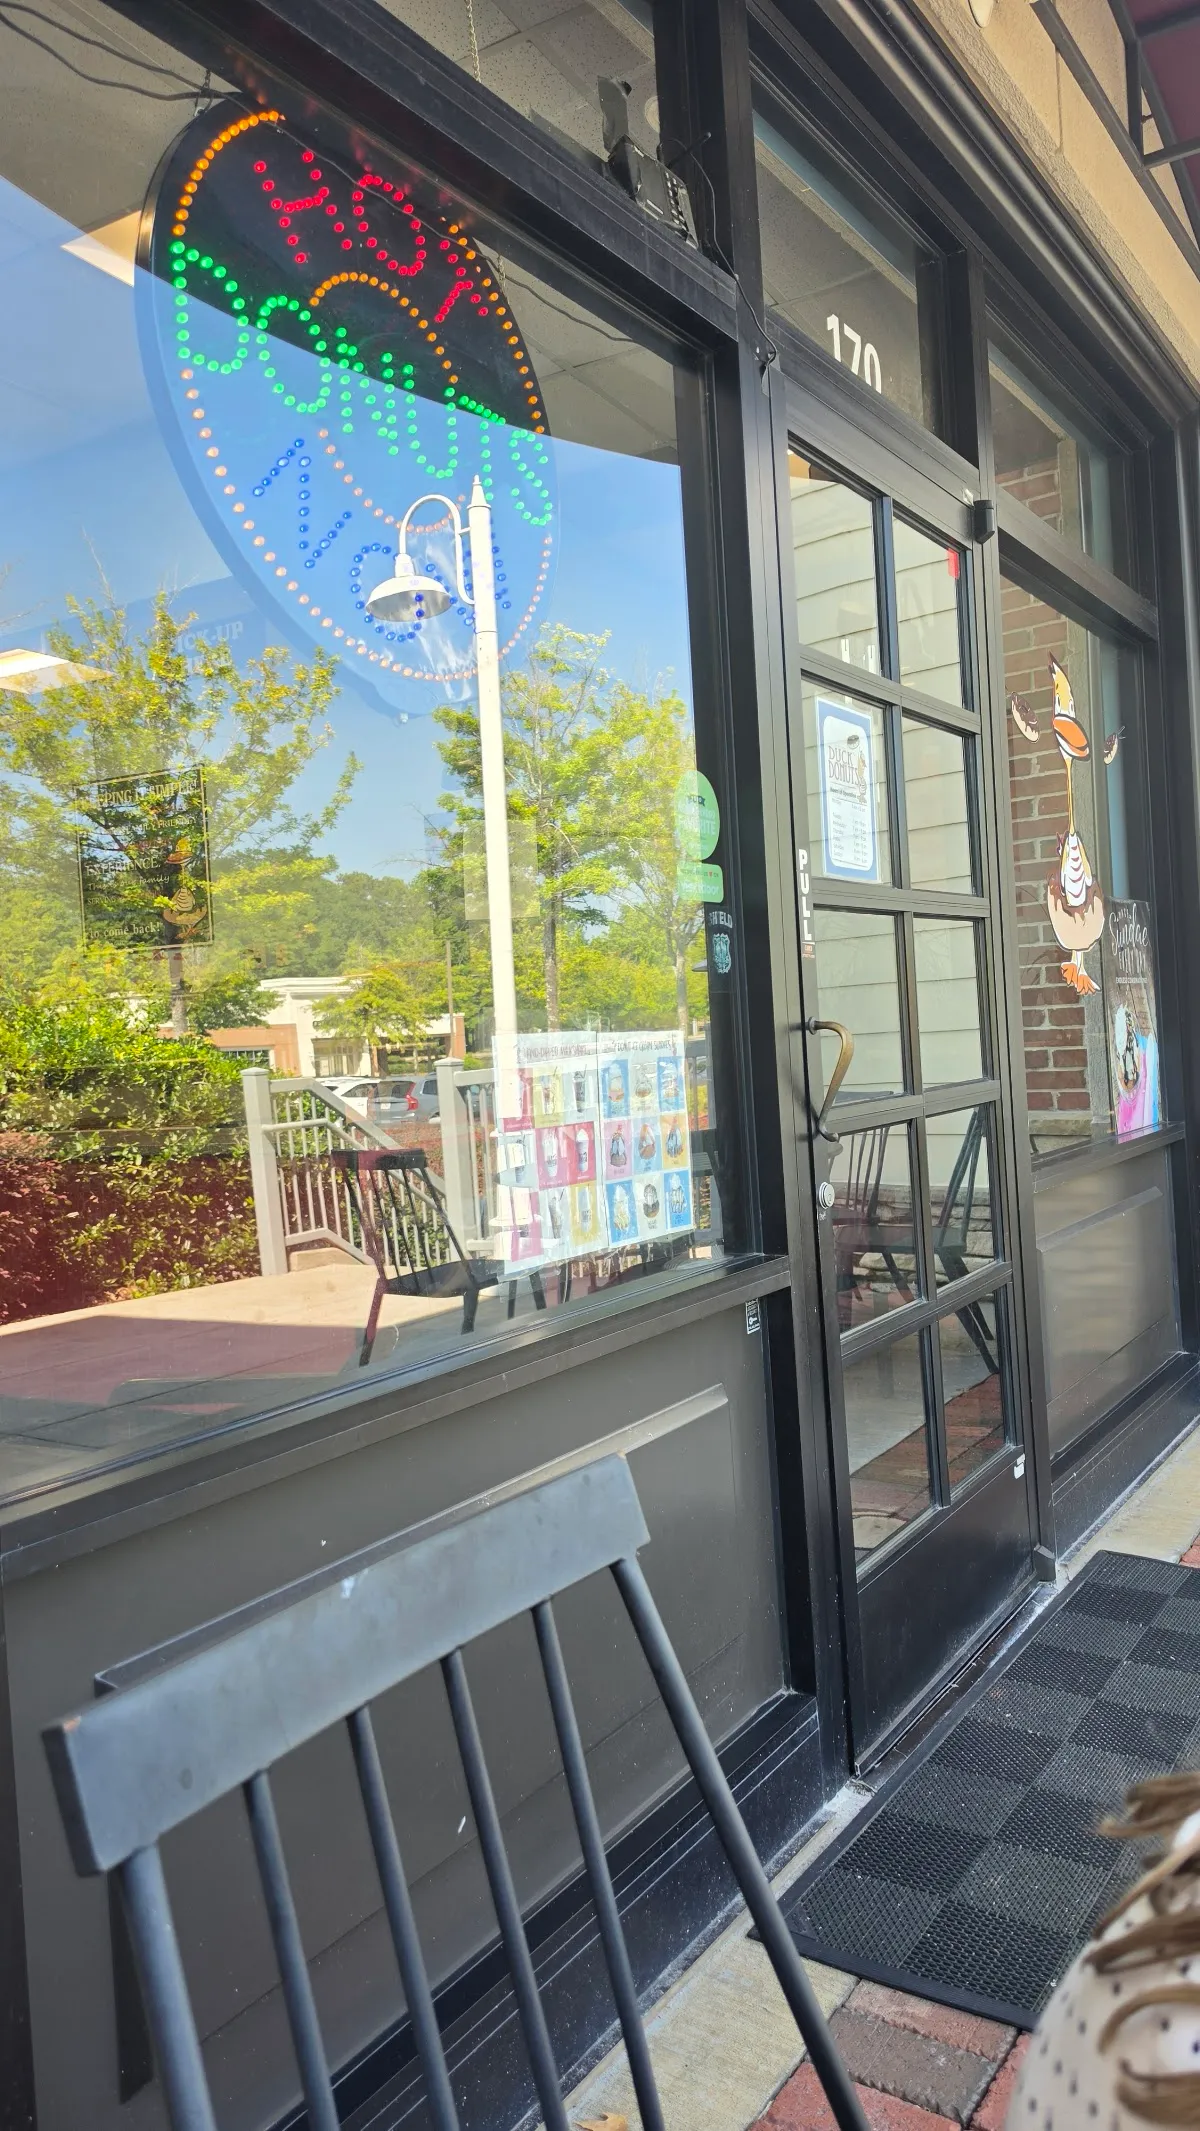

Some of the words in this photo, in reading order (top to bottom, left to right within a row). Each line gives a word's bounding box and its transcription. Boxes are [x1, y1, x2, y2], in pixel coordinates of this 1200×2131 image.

[254, 151, 489, 325] HOT
[827, 313, 882, 395] 170
[172, 241, 554, 526] DONUTS
[176, 620, 244, 653] ICK-UP
[828, 760, 860, 785] DONUTS
[829, 746, 853, 767] DUCK
[798, 848, 814, 941] PULL
[103, 925, 130, 937] come
[132, 921, 161, 935] back!
[709, 910, 733, 929] SHELD
[1109, 903, 1148, 955] Sundae
